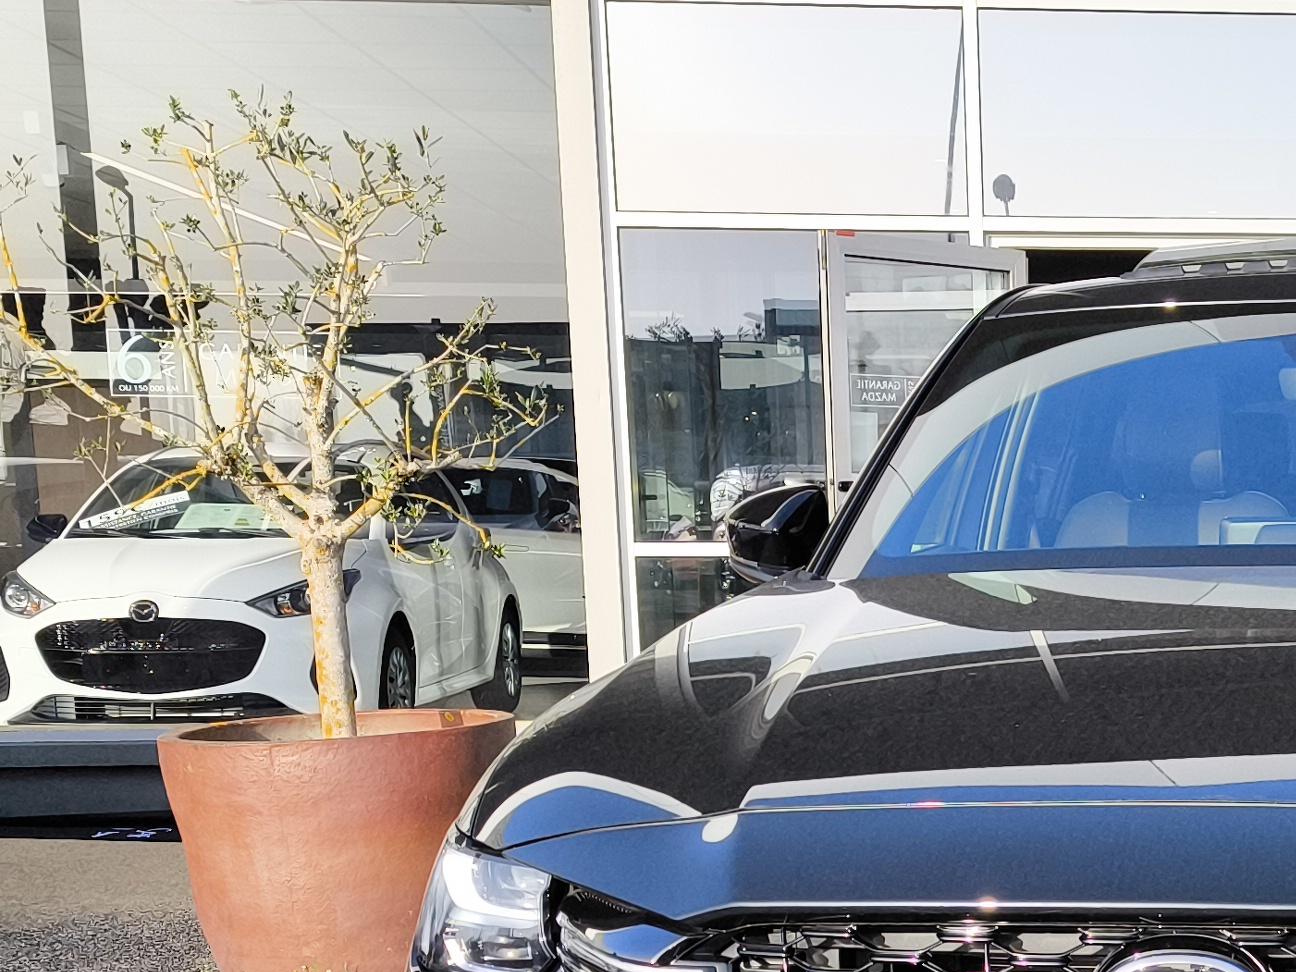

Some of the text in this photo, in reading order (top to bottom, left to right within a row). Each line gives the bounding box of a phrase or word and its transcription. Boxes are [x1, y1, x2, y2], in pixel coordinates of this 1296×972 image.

[117, 334, 152, 384] 6
[118, 384, 132, 392] OU
[133, 384, 149, 392] 150
